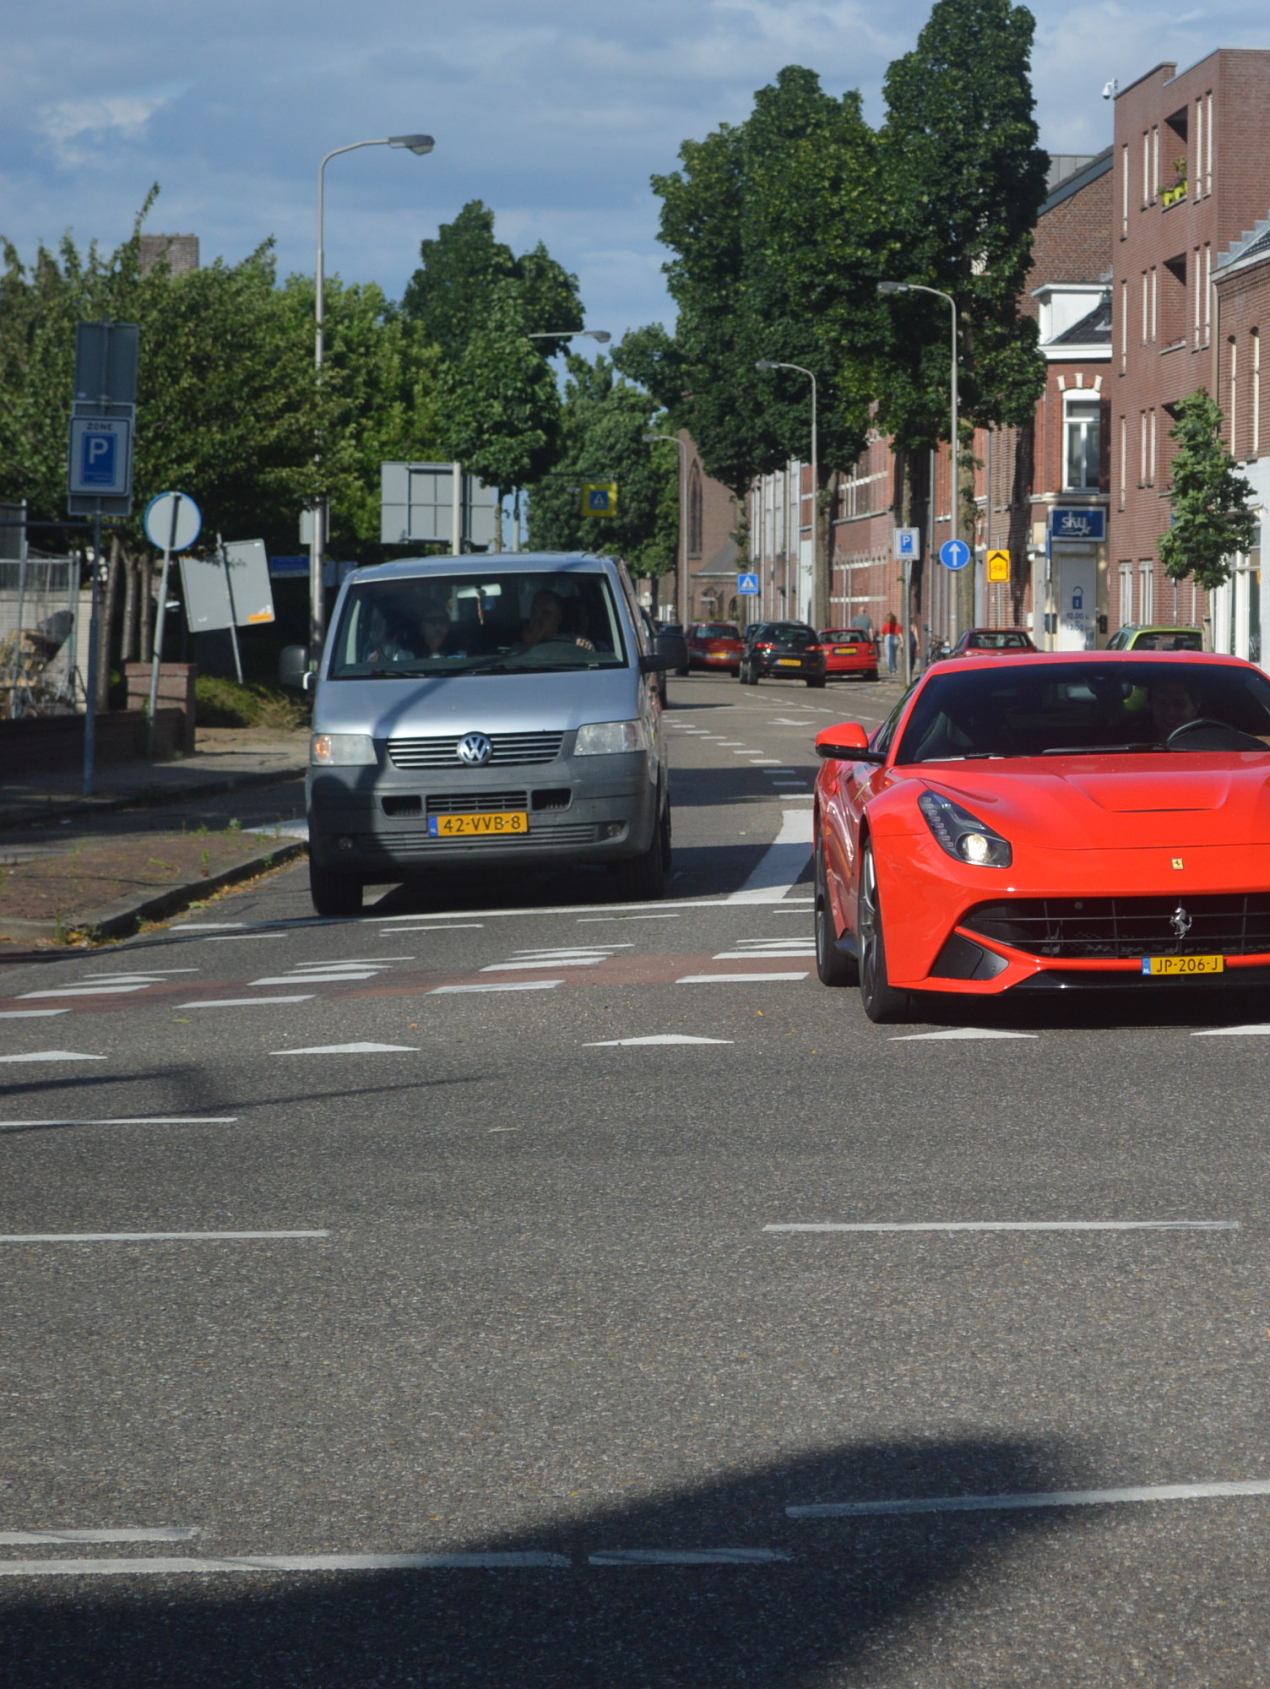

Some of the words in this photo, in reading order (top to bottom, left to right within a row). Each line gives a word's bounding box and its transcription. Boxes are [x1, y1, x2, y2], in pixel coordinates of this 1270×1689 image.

[86, 422, 112, 431] ZONE
[89, 438, 109, 464] P
[903, 535, 911, 547] P
[443, 815, 521, 832] 42-VVB-8
[1156, 957, 1218, 972] JP-206-J
